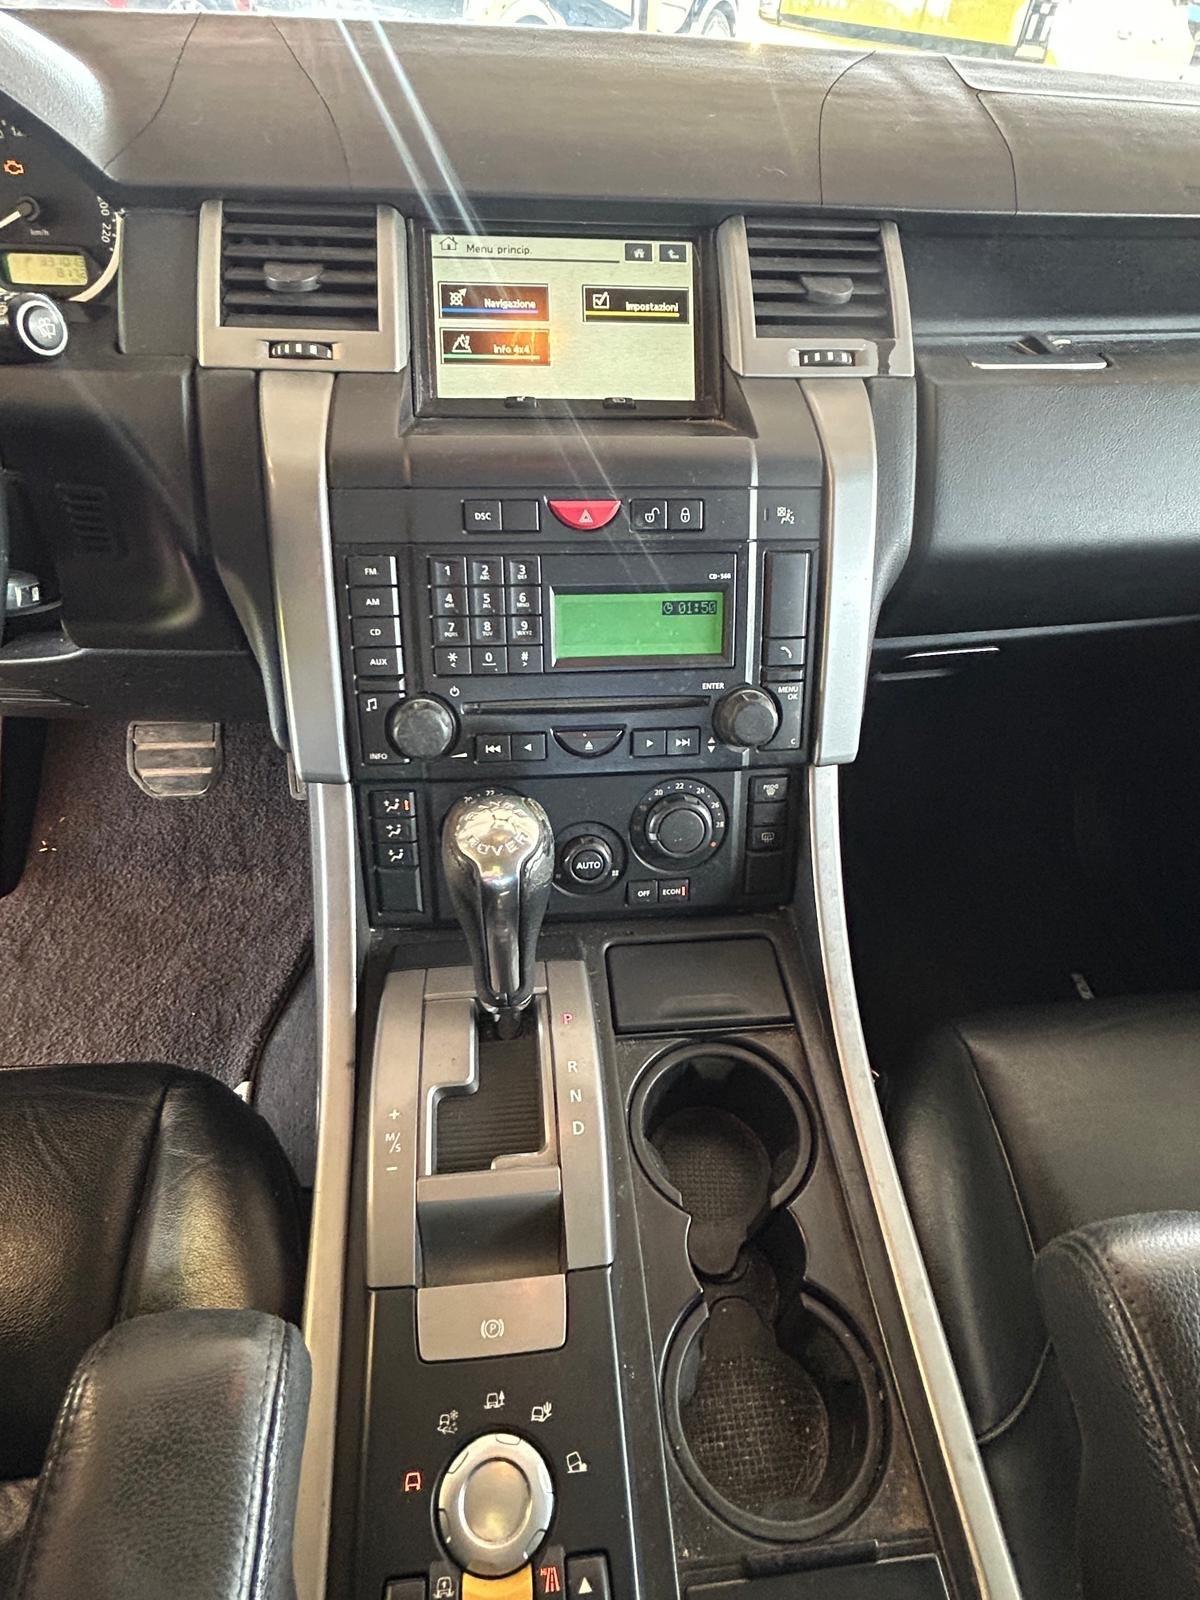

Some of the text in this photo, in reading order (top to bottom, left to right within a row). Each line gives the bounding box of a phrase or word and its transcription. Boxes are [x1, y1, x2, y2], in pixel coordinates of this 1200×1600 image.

[466, 244, 533, 256] Menu princip.
[484, 298, 536, 310] Navigazione
[625, 301, 679, 312] Impostazioni
[493, 343, 530, 354] Info 4x4
[474, 512, 492, 521] DSC
[364, 567, 377, 575] FM
[444, 565, 451, 576] 1
[481, 565, 489, 575] 2
[519, 565, 526, 575] 3
[366, 598, 380, 606] AM
[445, 593, 453, 603] 4
[483, 593, 490, 603] 5
[519, 592, 527, 602] 6
[678, 602, 716, 614] 01:50
[447, 622, 455, 632] 7
[483, 621, 491, 631] 8
[521, 621, 528, 631] 9
[369, 628, 381, 636] CD
[370, 658, 387, 666] AUX
[485, 652, 493, 662] 0
[702, 682, 724, 690] ENTER
[778, 685, 799, 693] MENU
[711, 801, 720, 809] 26
[576, 861, 600, 870] AUTO
[637, 889, 650, 897] OFF
[662, 888, 681, 896] ECON
[563, 1013, 573, 1024] P
[568, 1061, 577, 1073] R
[571, 1089, 582, 1102] N
[572, 1122, 585, 1135] D
